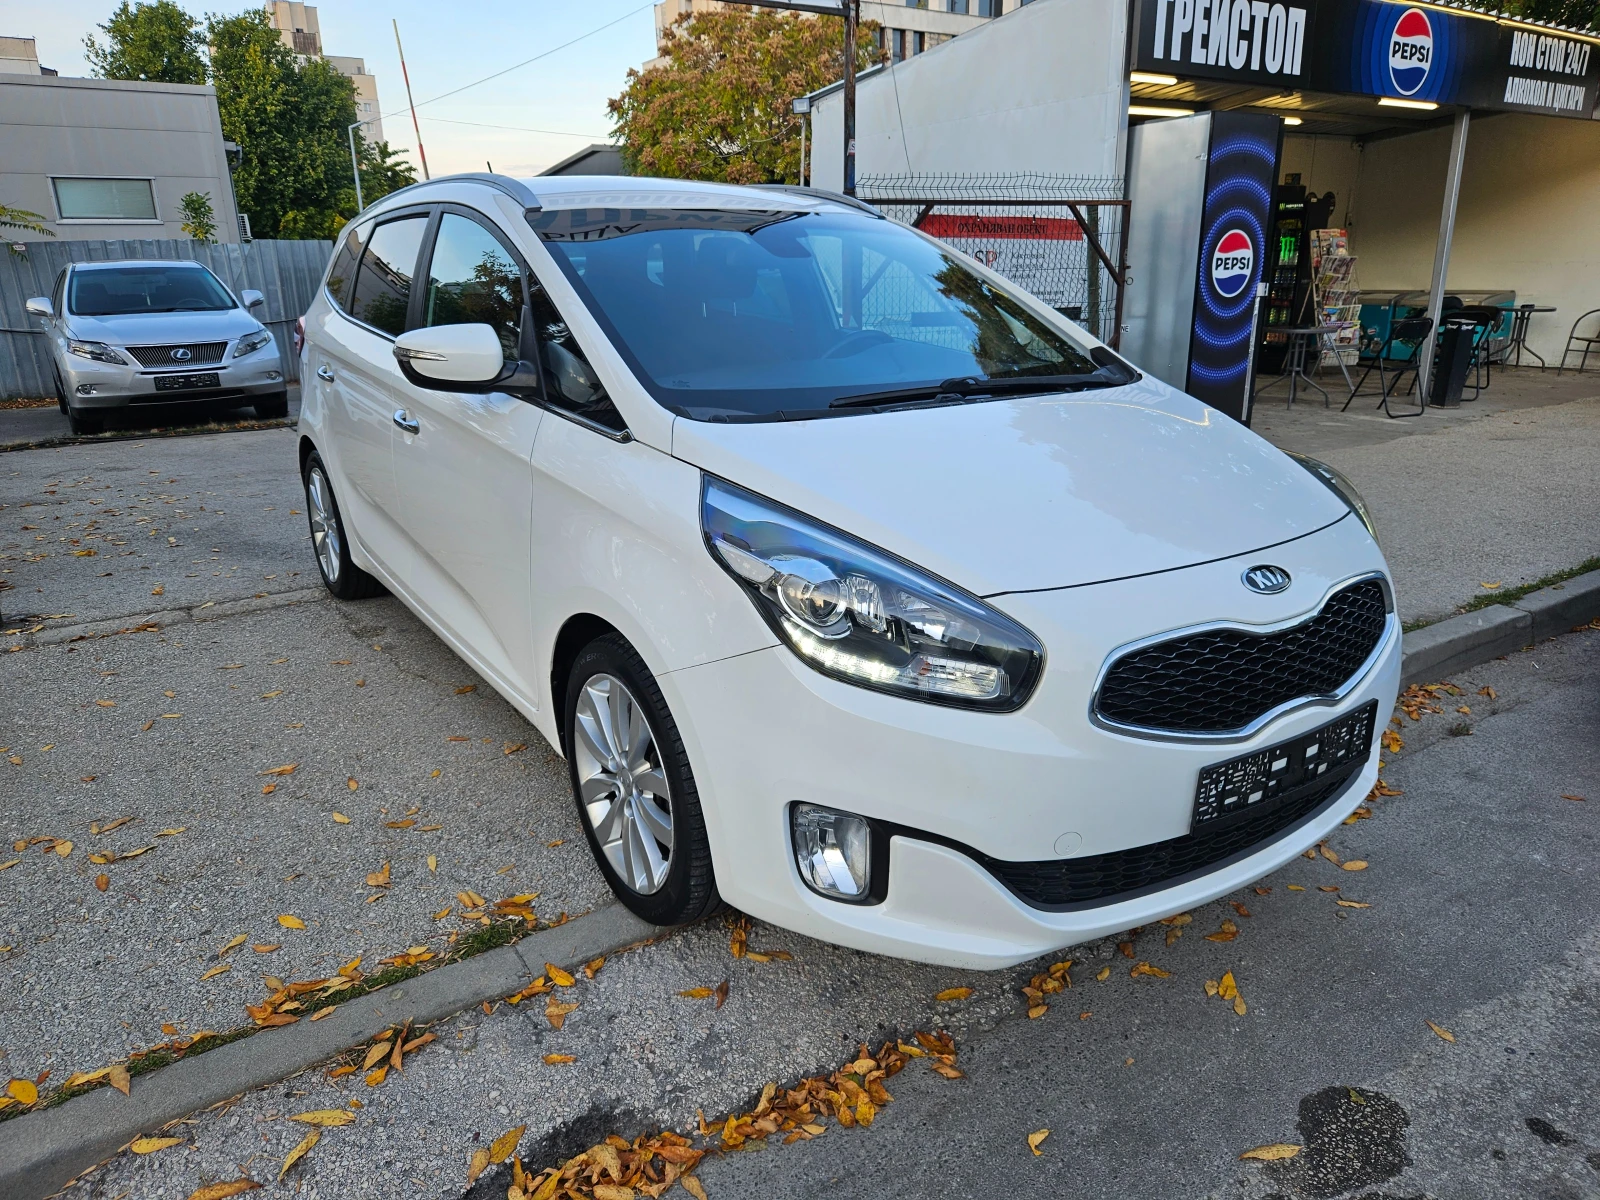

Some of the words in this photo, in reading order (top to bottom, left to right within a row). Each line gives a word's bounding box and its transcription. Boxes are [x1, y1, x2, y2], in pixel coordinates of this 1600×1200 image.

[1392, 41, 1430, 63] PEPSI
[1510, 31, 1537, 67] НОН
[1536, 36, 1566, 72] СТОП
[1565, 41, 1590, 76] 24/7
[1504, 76, 1548, 106] АЛКОХОЛ
[1546, 82, 1555, 107] И
[1553, 82, 1585, 112] ЦИГАРИ
[957, 222, 1014, 234] ОХРАНЯВАН
[1215, 257, 1250, 271] PEPSI
[1248, 567, 1289, 589] KIA
